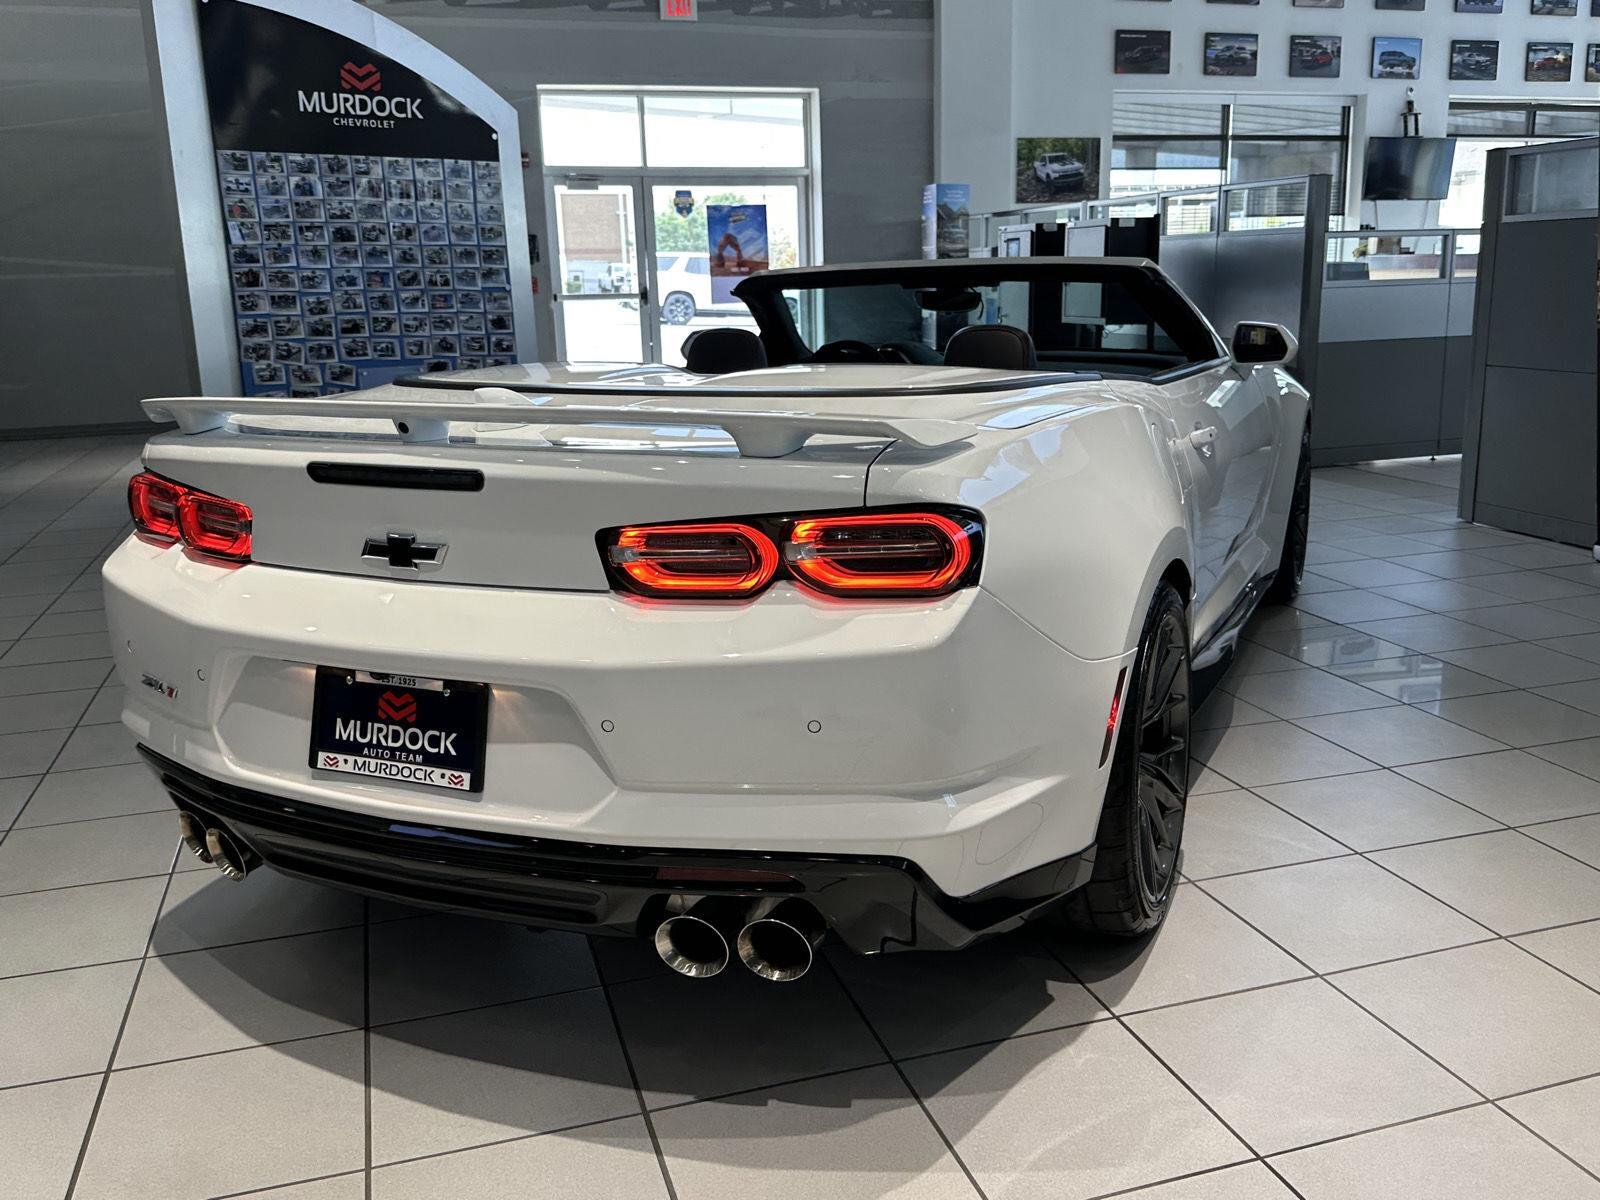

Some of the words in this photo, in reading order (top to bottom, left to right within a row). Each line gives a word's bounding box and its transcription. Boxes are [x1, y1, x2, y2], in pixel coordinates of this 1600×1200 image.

[666, 0, 692, 17] EXIT
[297, 90, 424, 119] MURDOCK
[333, 117, 395, 129] CHEVROLET
[398, 676, 417, 687] 1925
[335, 717, 458, 756] MURDOCK
[362, 747, 391, 759] AUTO
[395, 751, 423, 763] TEAM
[353, 758, 436, 783] MURDOCK
